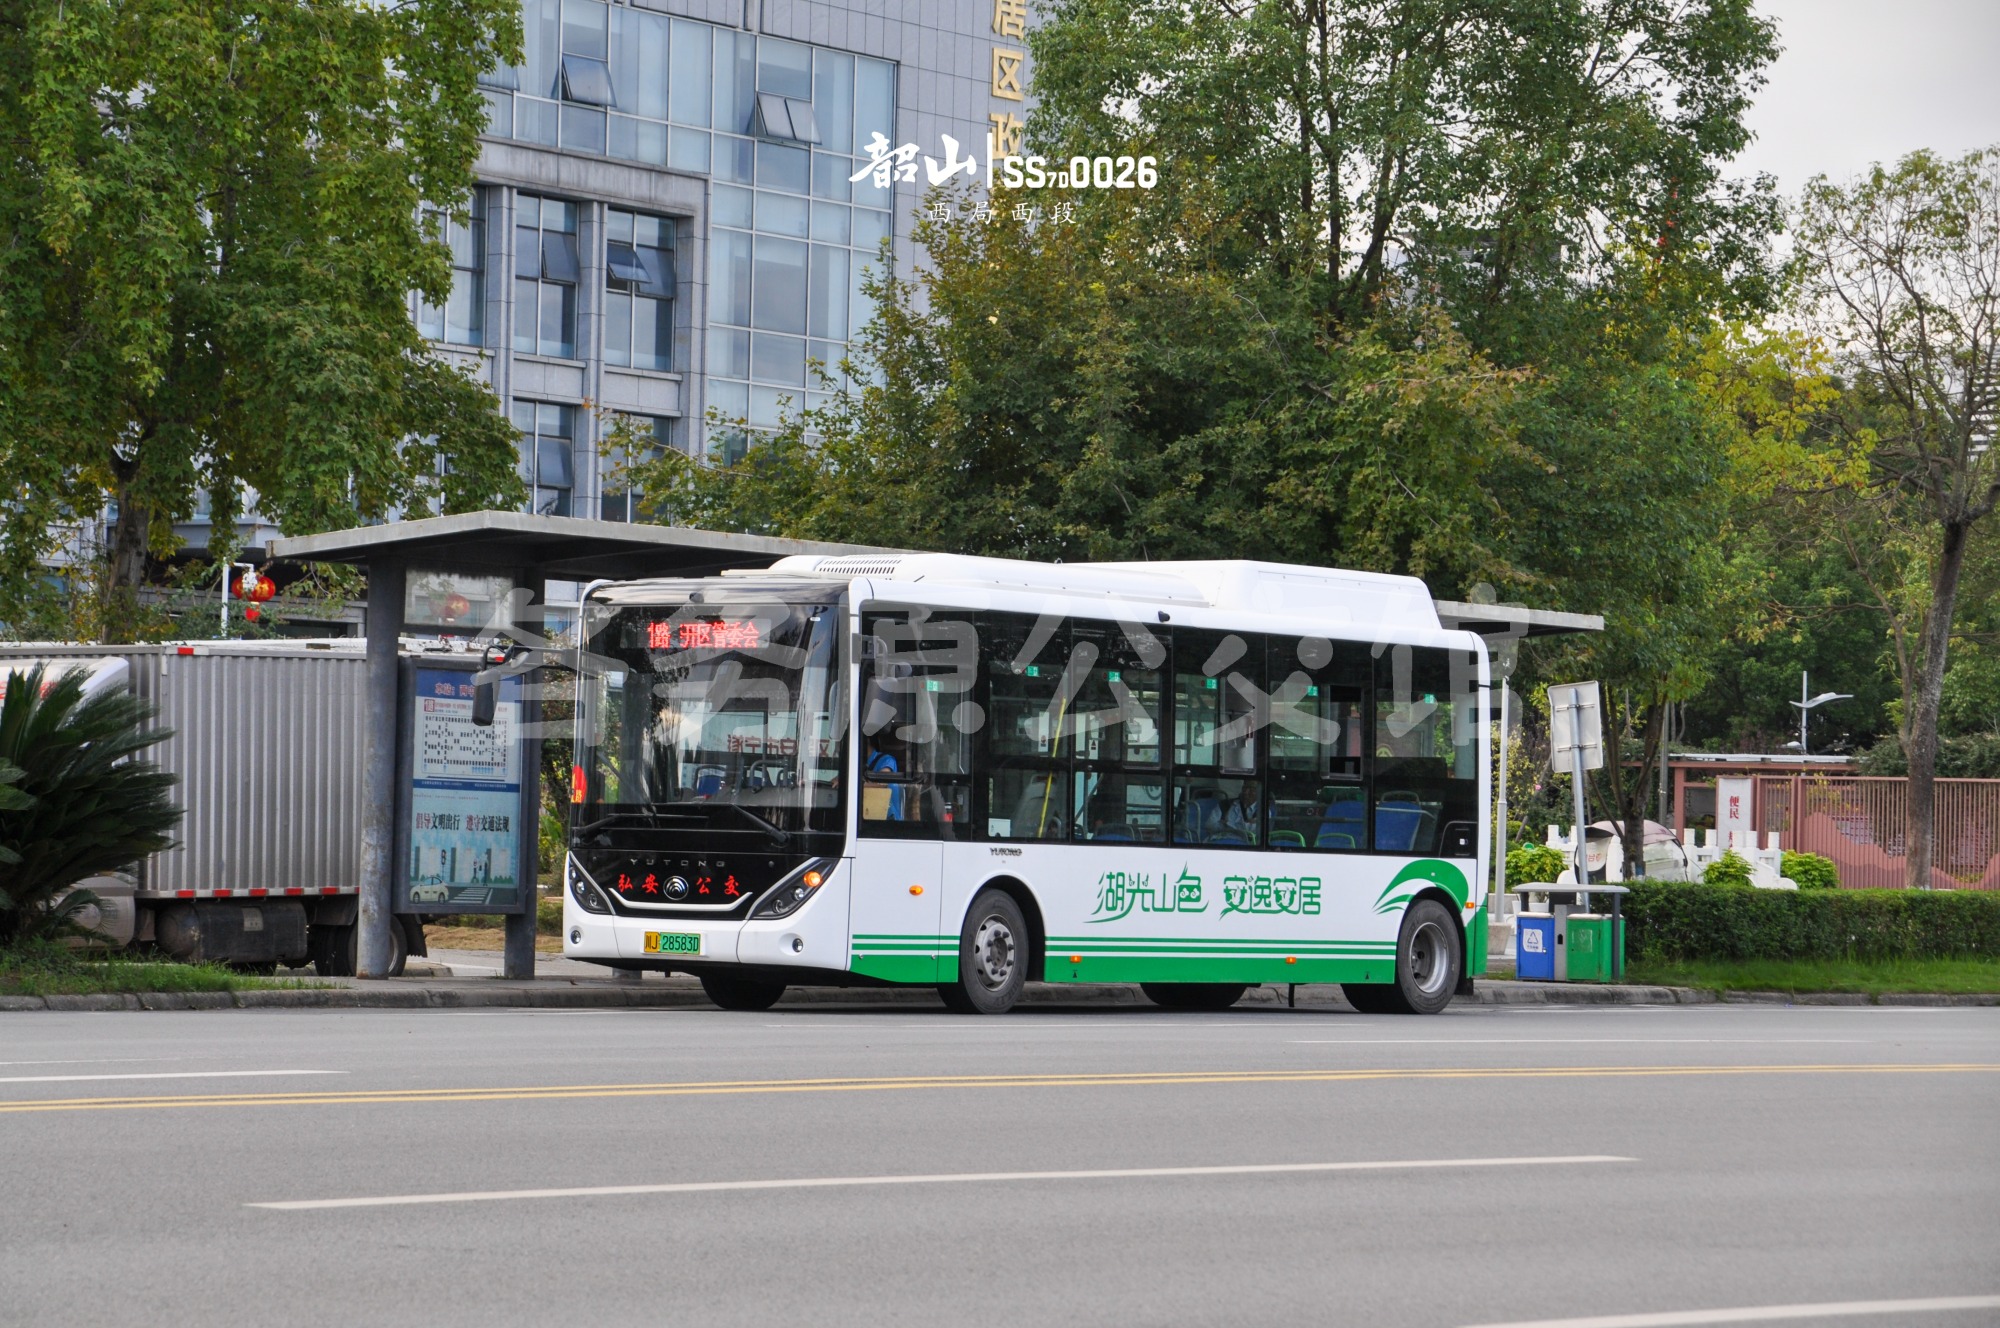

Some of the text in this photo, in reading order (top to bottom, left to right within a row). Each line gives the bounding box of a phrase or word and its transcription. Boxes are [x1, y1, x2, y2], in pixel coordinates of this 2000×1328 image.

[680, 622, 759, 648] 开区管委会
[415, 813, 510, 832] 倡导文明出行 遵守交通法规
[630, 858, 726, 868] YUTONG
[618, 873, 740, 897] 弘安 公交
[1083, 860, 1322, 924] 湖光山色 安逸安居
